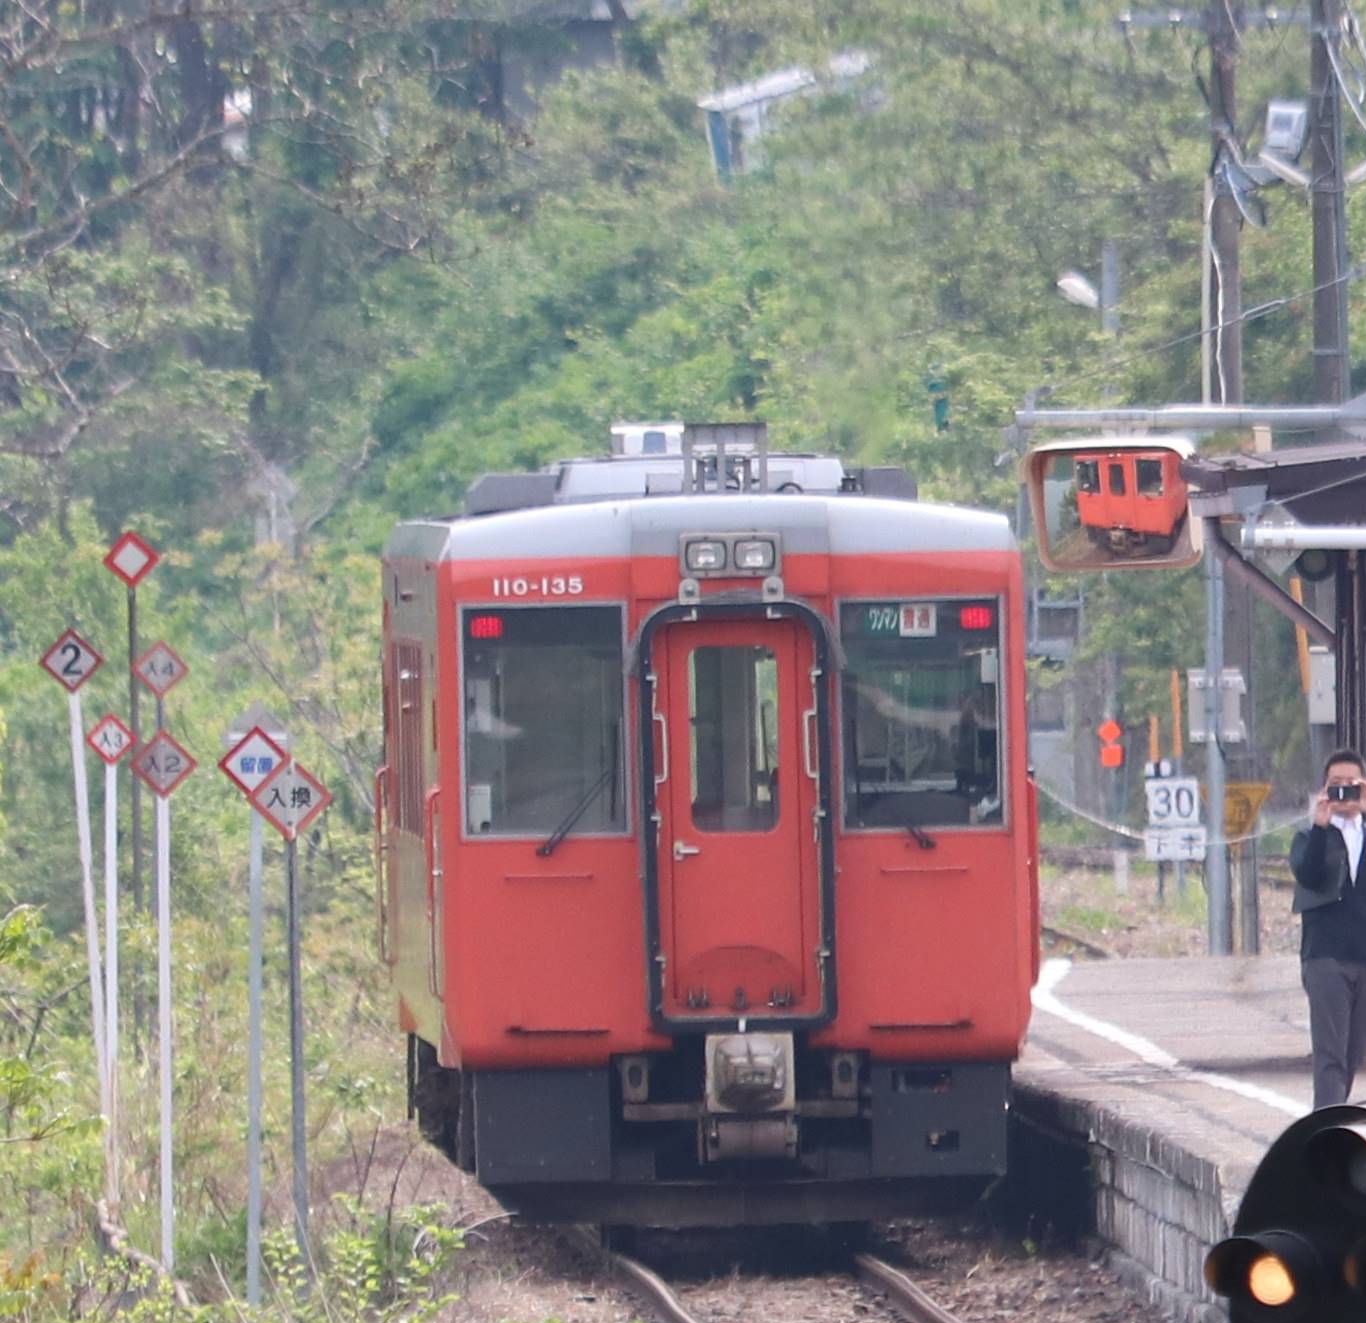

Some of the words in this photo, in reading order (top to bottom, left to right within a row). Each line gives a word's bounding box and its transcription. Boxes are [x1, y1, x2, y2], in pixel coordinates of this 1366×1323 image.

[493, 577, 583, 596] 110-135
[61, 643, 83, 676] 2
[266, 786, 312, 808] 入換
[1153, 786, 1194, 818] 30
